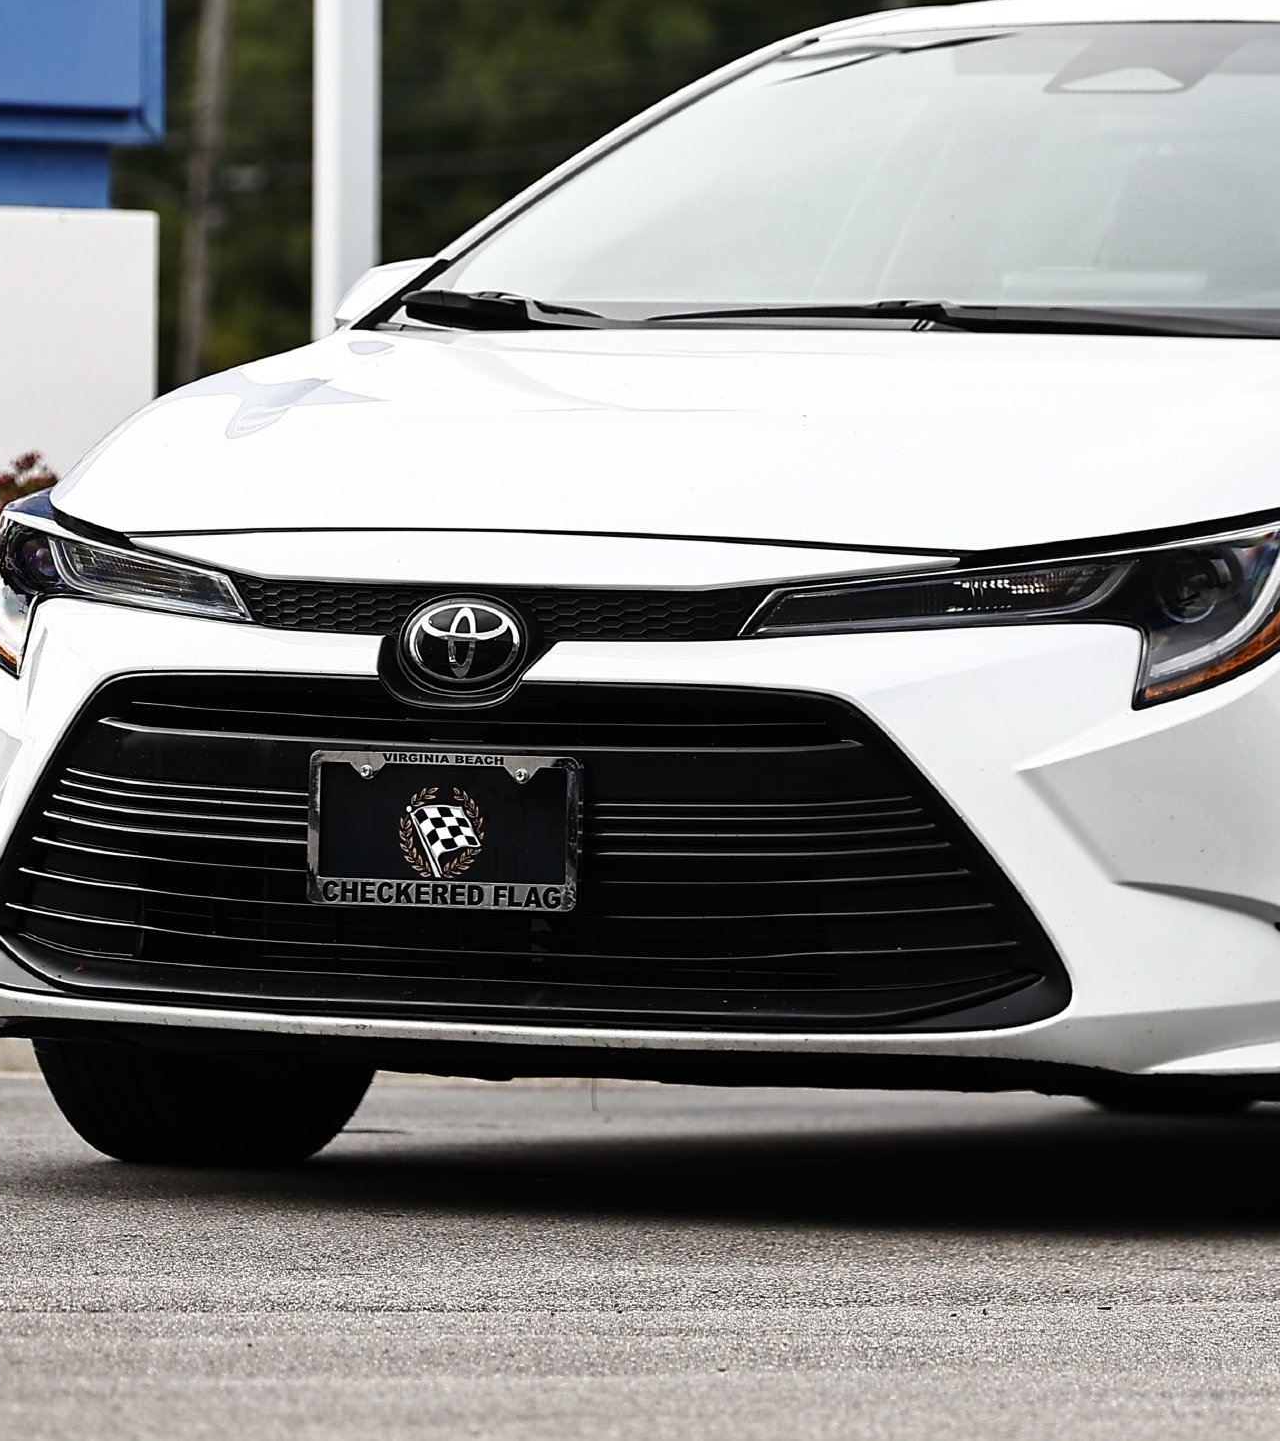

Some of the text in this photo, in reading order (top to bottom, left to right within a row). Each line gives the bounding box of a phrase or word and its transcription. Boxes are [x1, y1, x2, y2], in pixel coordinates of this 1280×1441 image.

[382, 752, 505, 766] VIRGINIA BEACH
[322, 880, 561, 909] CHECKERED FLAG
